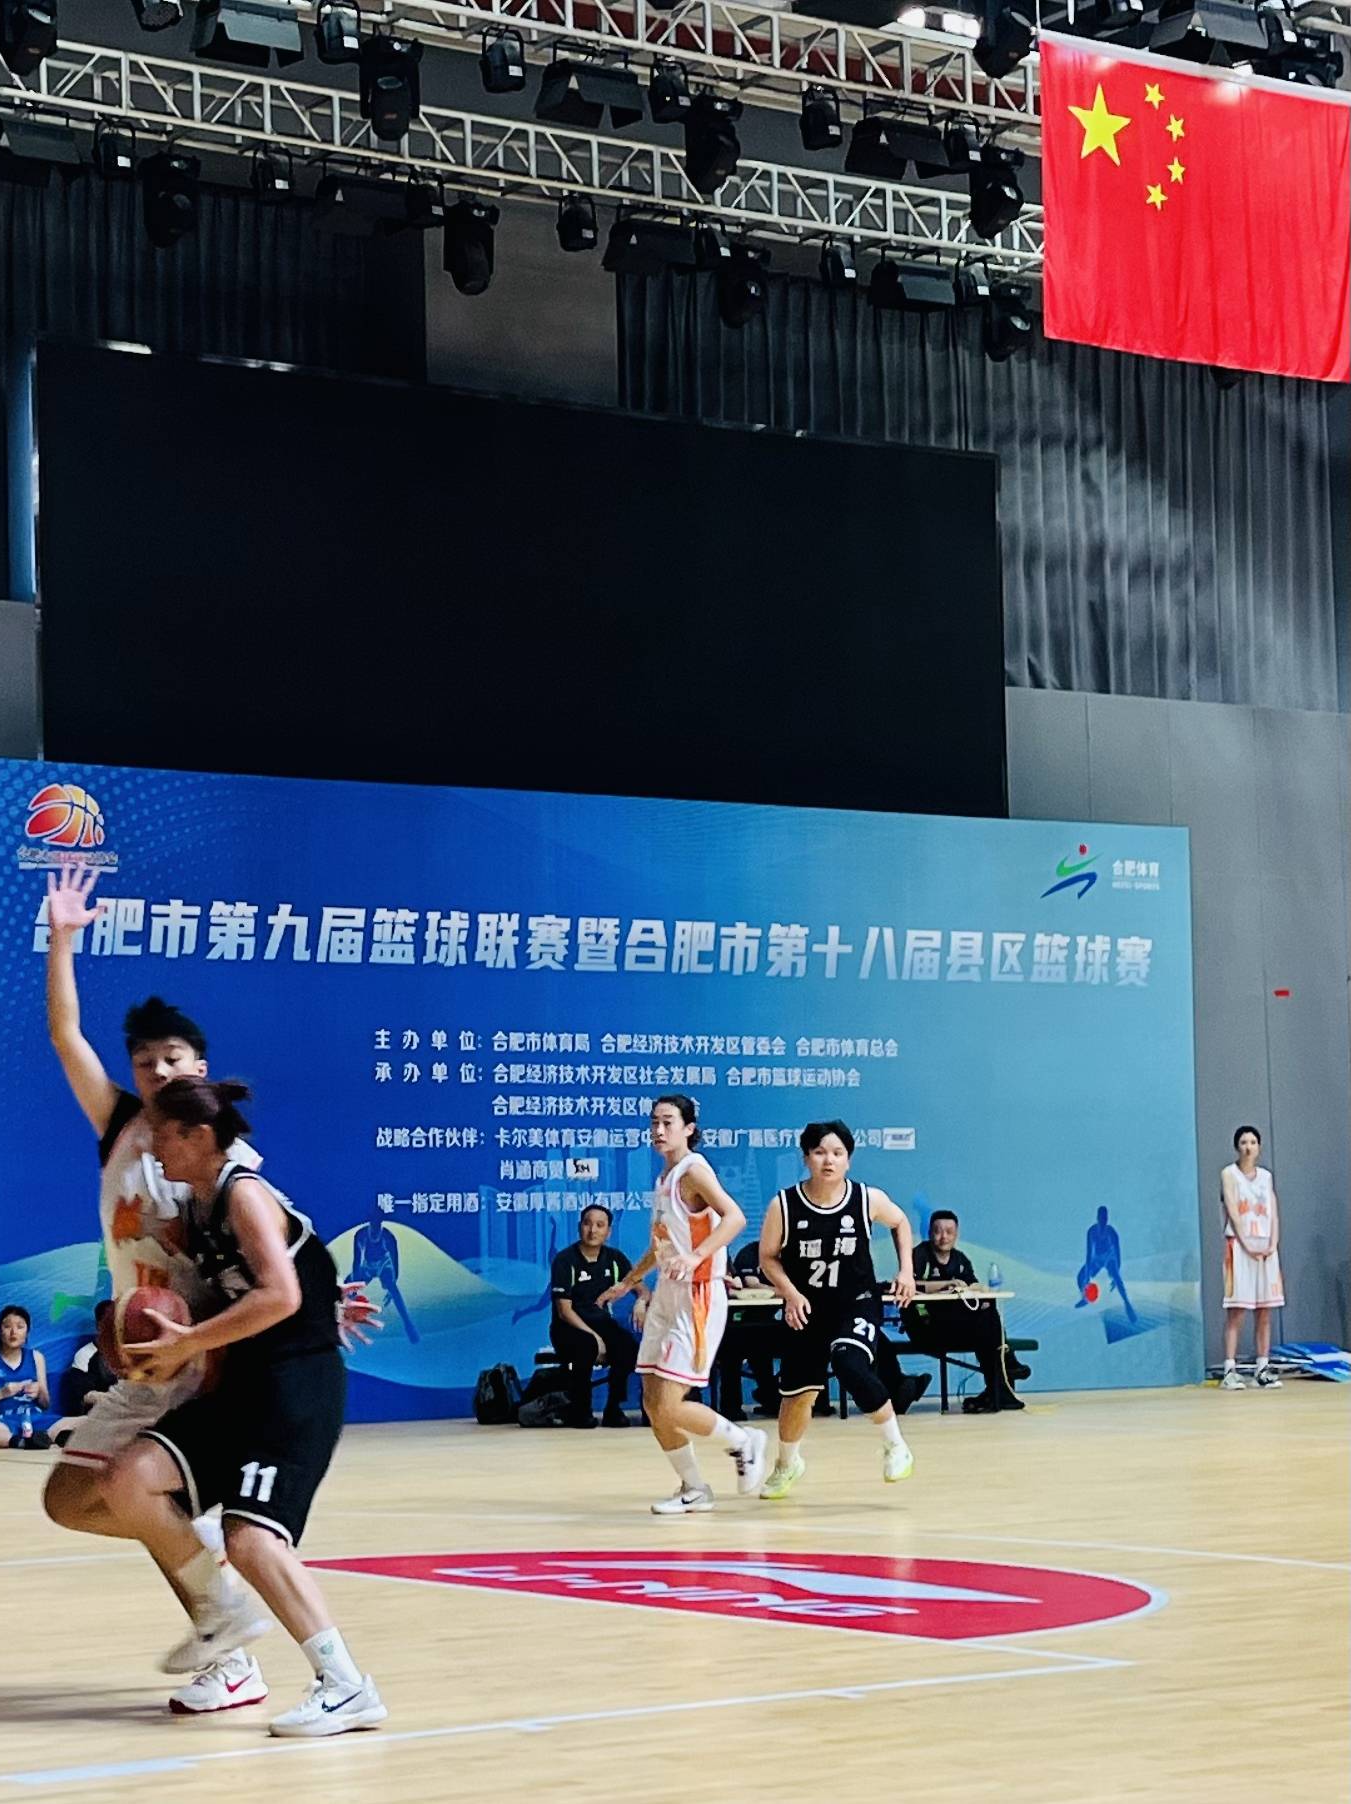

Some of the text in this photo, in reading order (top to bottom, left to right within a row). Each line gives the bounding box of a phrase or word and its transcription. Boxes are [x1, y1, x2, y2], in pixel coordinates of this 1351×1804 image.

[1112, 859, 1160, 878] 合肥体育
[491, 1031, 591, 1053] 合肥市体育局
[600, 1033, 787, 1057] 合肥经济技术开发区管委会
[796, 1036, 899, 1058] 合肥市体育总会
[492, 1063, 717, 1087] 合肥经济技术开发区社会发展局
[725, 1067, 861, 1089] 合肥市篮球运动协会
[491, 1094, 701, 1117] 合肥经济技术开发区体
[808, 1259, 841, 1288] 21
[853, 1317, 876, 1342] 21
[240, 1461, 278, 1502] 11
